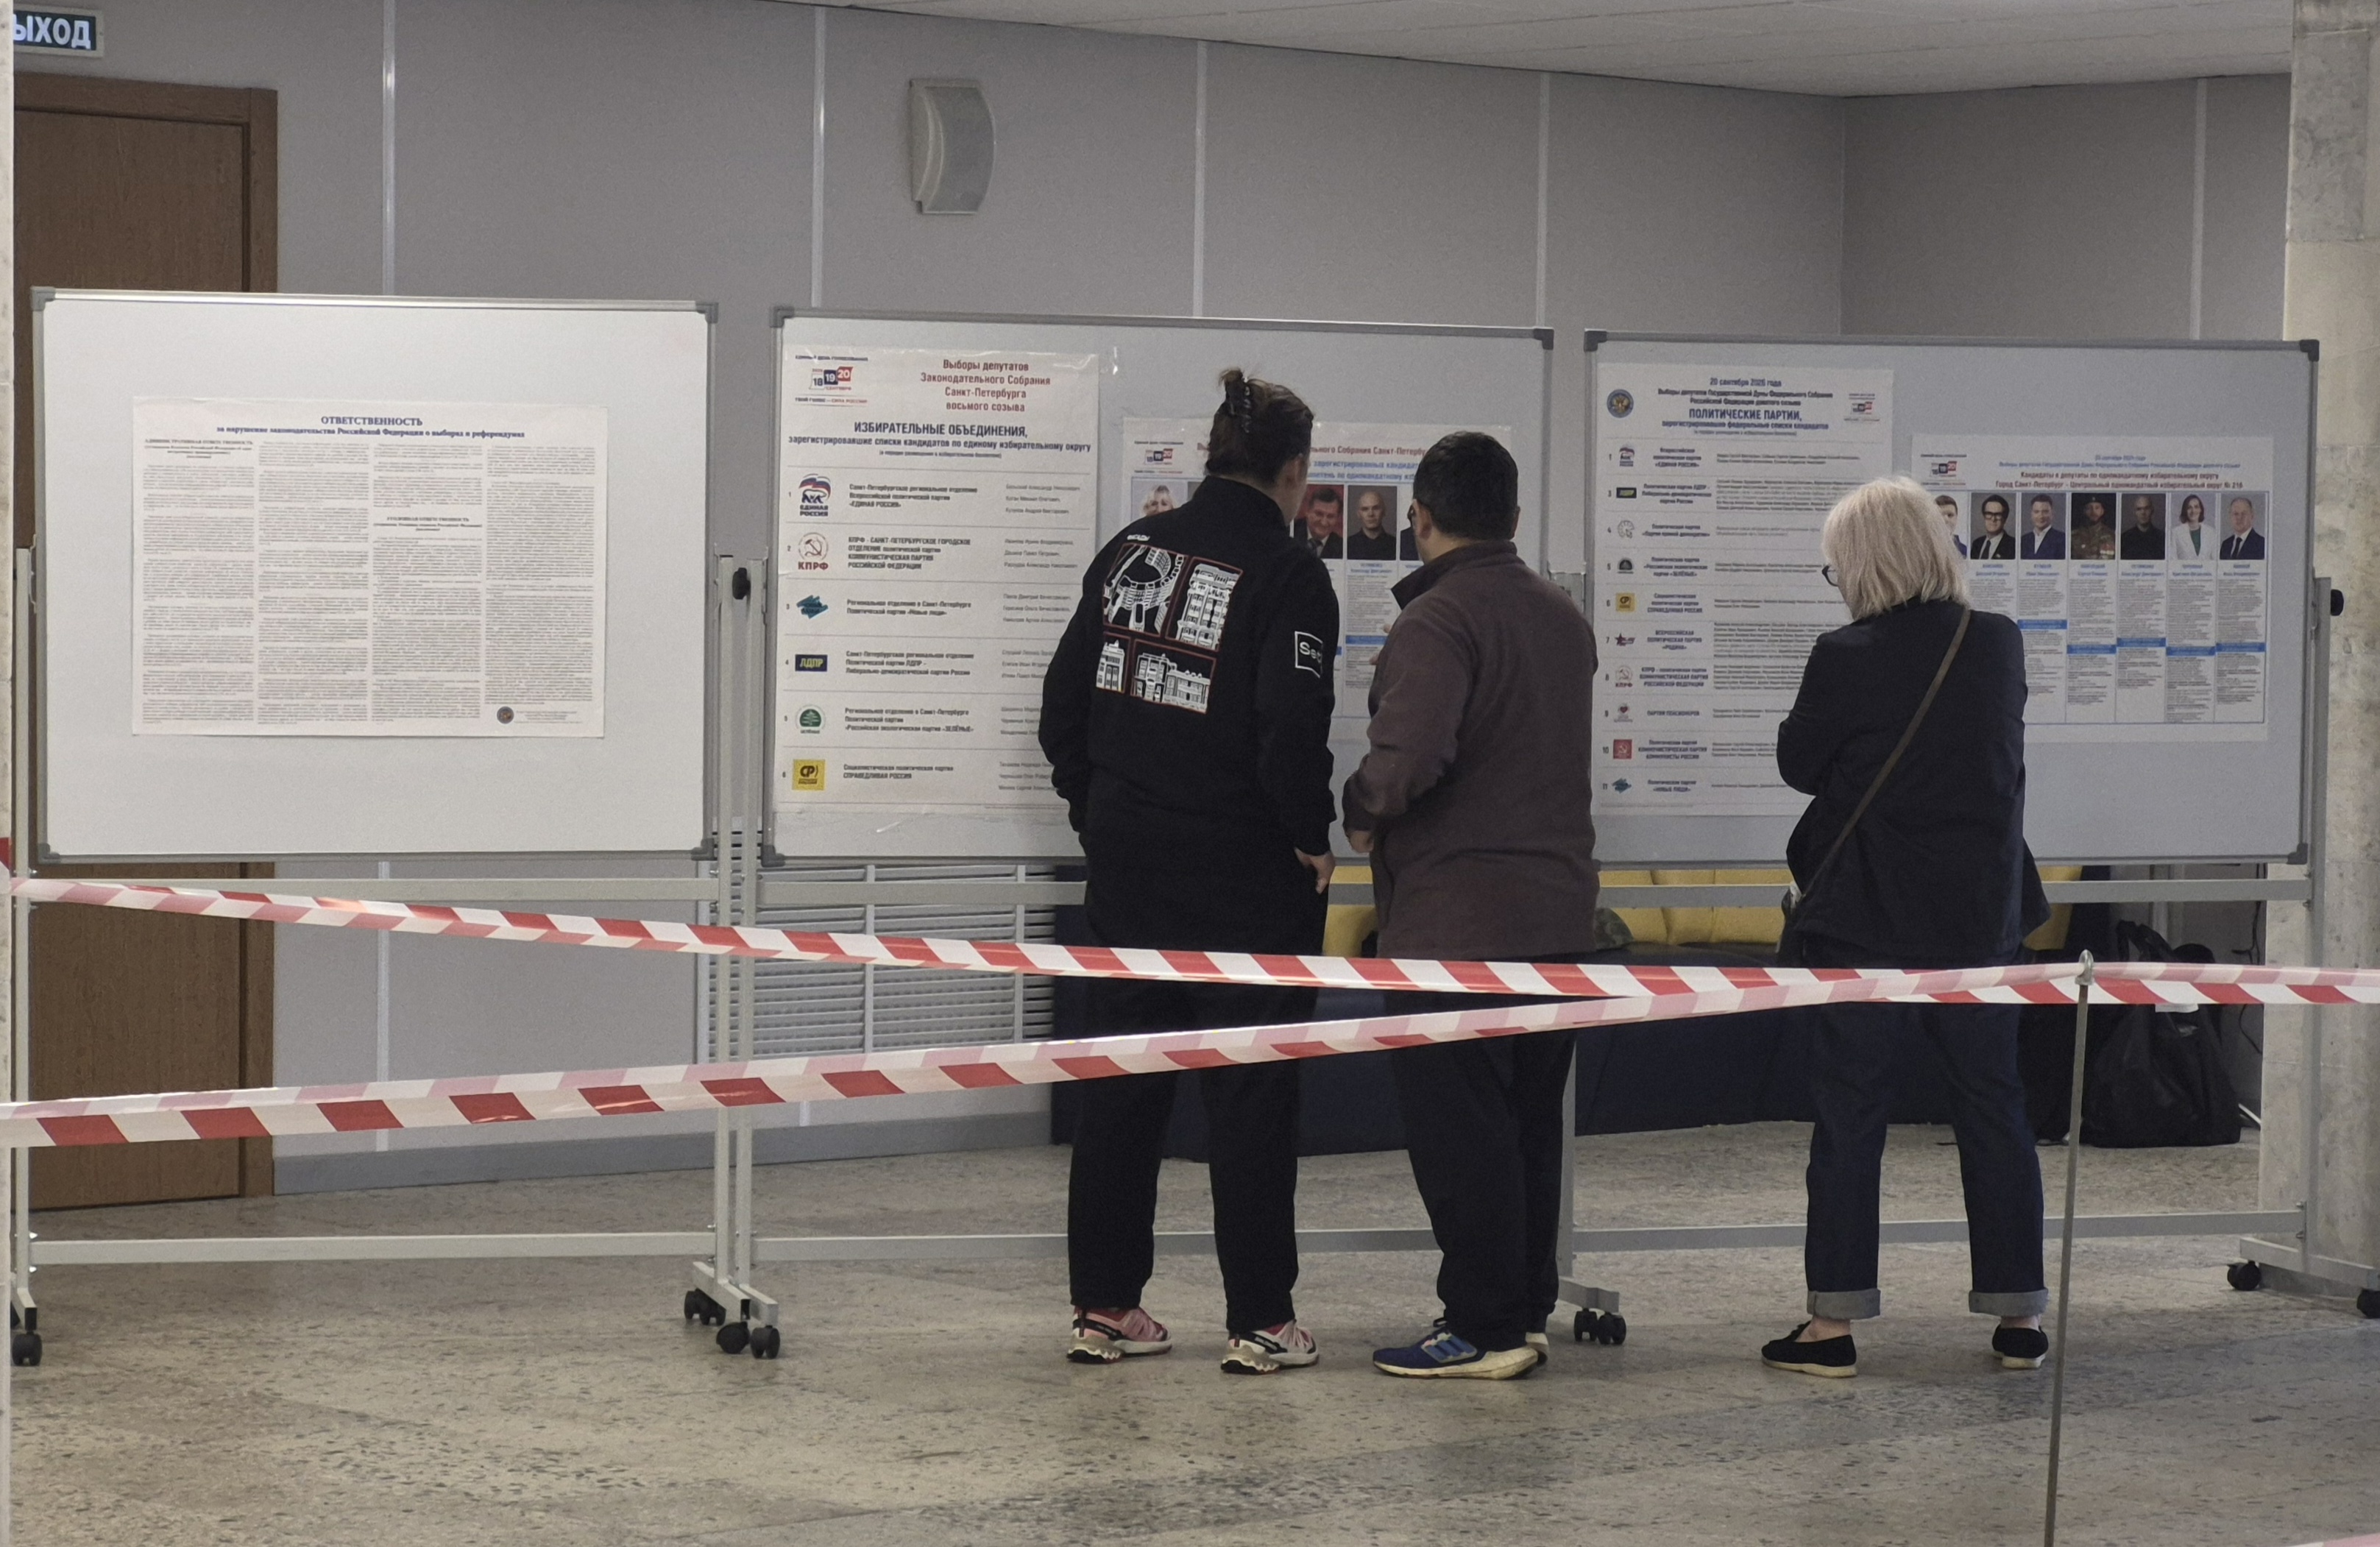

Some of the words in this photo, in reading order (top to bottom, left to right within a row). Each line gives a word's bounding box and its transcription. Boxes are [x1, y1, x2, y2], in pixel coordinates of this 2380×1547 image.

[13, 14, 91, 49] ЫХОД
[943, 359, 980, 372] Выборы
[982, 362, 1029, 372] депутатов
[813, 378, 824, 386] 18
[825, 373, 835, 382] 19
[837, 369, 850, 378] 20
[921, 372, 1005, 384] Законодательного
[1007, 375, 1050, 386] Собрания
[1710, 378, 1718, 386] 20
[1767, 380, 1782, 388] года
[945, 386, 1027, 400] Санкт-Петербурга
[946, 402, 988, 411] восьмого
[991, 403, 1024, 411] созыва
[321, 416, 423, 426] ОТВЕТСТВЕННОСТЬ
[1689, 408, 1761, 420] ПОЛИТИЧЕСКИЕ
[1764, 410, 1802, 422] ПАРТИИ,
[382, 428, 424, 437] Федерации
[854, 422, 945, 435] ИЗБИРАТЕЛЬНЫЕ
[948, 424, 1028, 438] ОБЪЕДИНЕНИЯ,
[788, 436, 873, 446] зарегистрировавшие
[874, 438, 902, 446] списки
[904, 439, 949, 447] кандидатов
[963, 440, 997, 450] единому
[999, 439, 1063, 451] избирательному
[1066, 442, 1091, 453] округу
[1338, 445, 1371, 456] Собрания
[1373, 446, 1426, 456] Санкт-Петербу
[2014, 480, 2063, 489] Санкт-Петербург
[798, 562, 829, 570] КПРФ
[800, 658, 824, 668] ЛДПР
